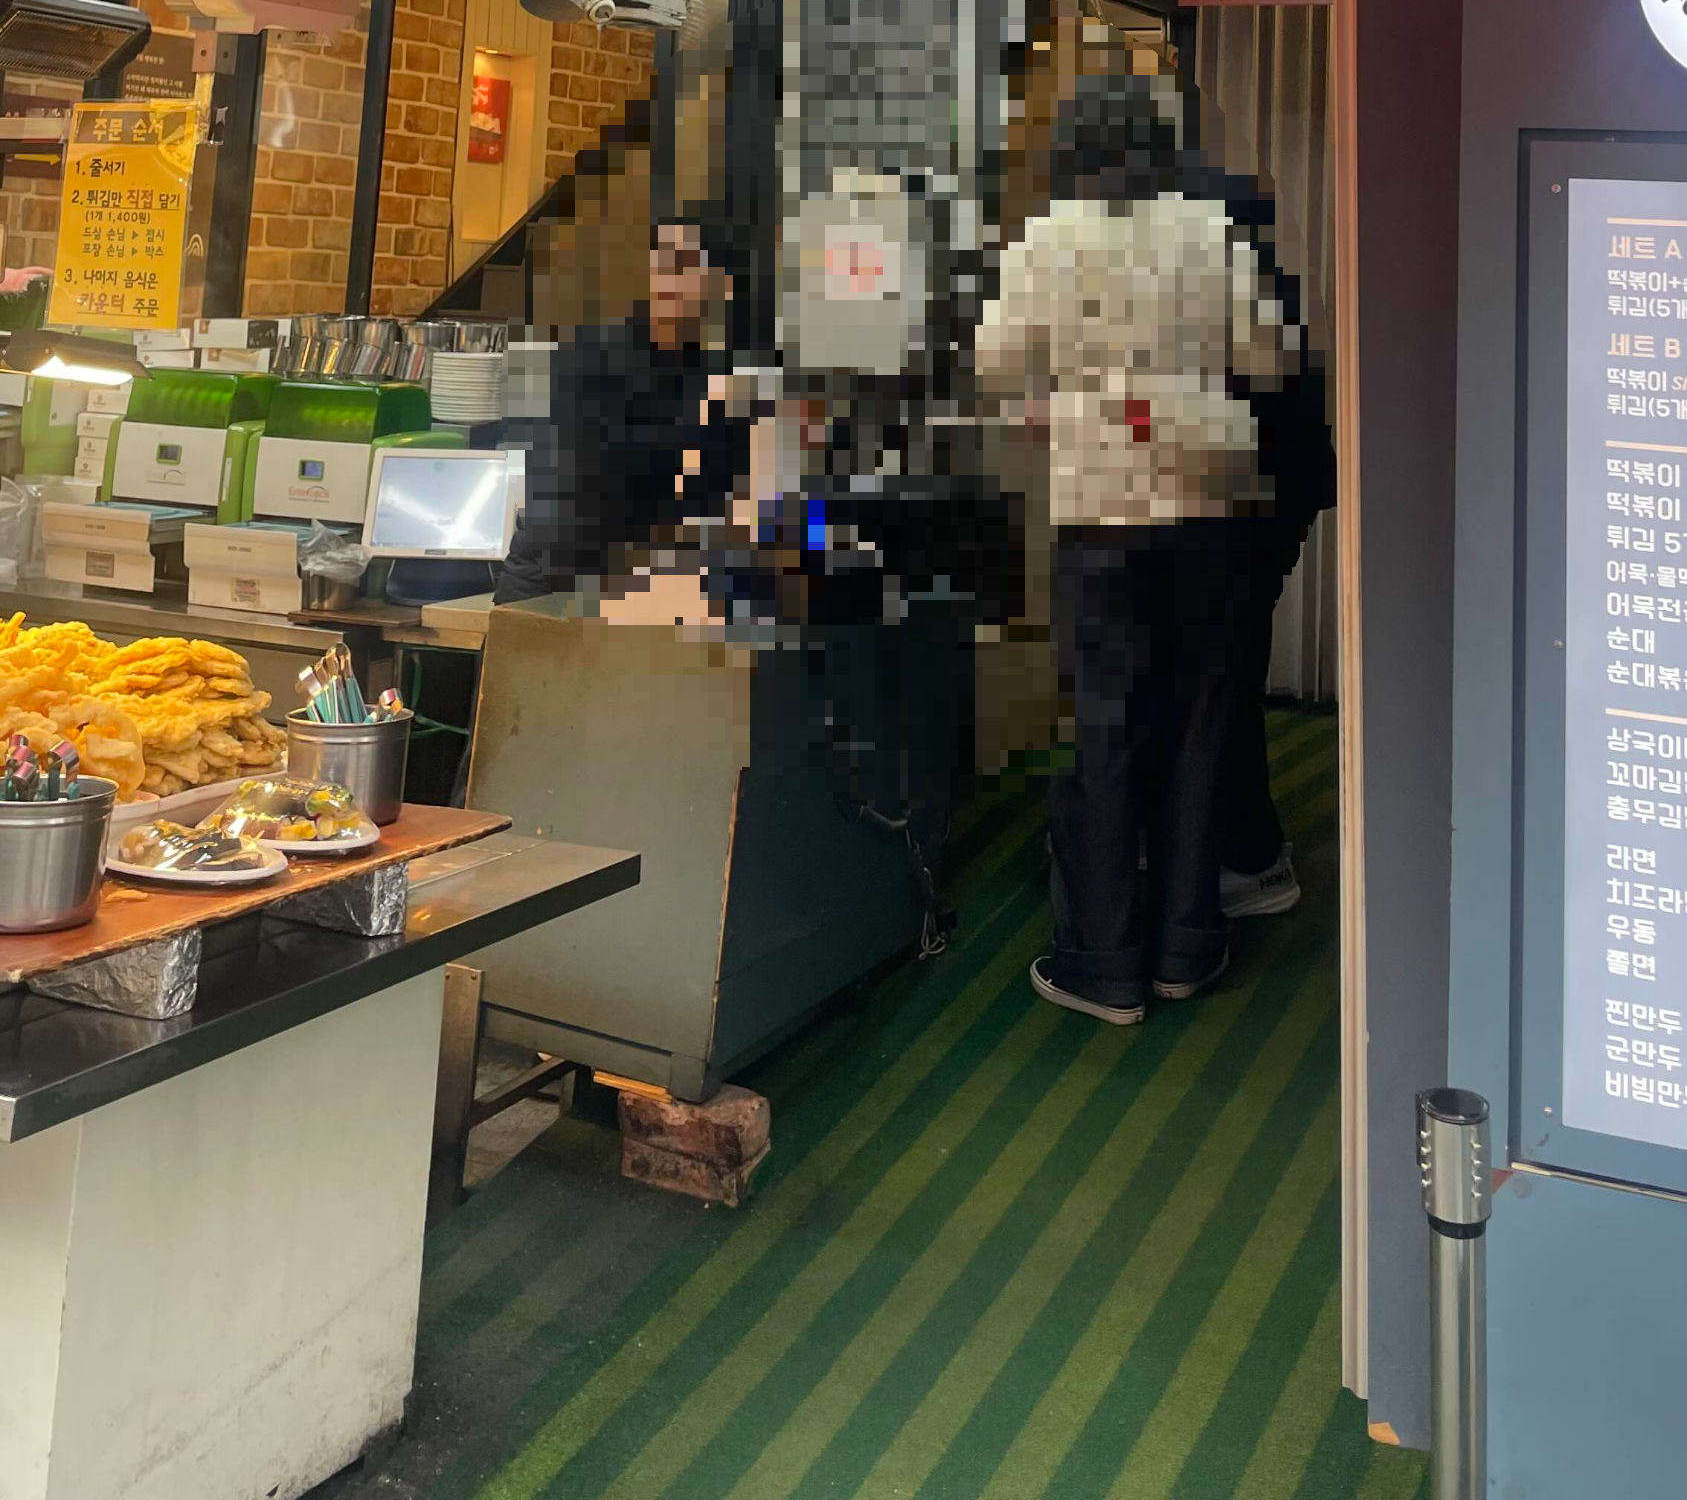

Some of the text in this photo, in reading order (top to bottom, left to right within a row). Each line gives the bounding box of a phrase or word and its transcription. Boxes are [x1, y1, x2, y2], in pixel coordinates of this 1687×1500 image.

[93, 118, 164, 142] 주문 순서
[89, 158, 125, 177] 줄서기
[86, 189, 122, 207] 튀김만
[127, 189, 154, 208] 직접
[159, 194, 180, 209] 담기
[107, 227, 125, 241] 손님
[146, 229, 165, 243] 접시
[1608, 236, 1682, 259] 세트 A
[106, 244, 125, 258] 손님
[145, 246, 164, 259] 박스
[84, 269, 118, 286] 나머지
[79, 293, 159, 317] 카운터 주문
[1607, 333, 1681, 358] 세트 B
[1607, 368, 1667, 392] 떡볶이
[1607, 459, 1680, 488] 떡볶이
[1607, 492, 1680, 521] 떡볶이
[1607, 525, 1687, 554] 튀김 5
[1607, 592, 1687, 623] 어묵전
[1607, 626, 1655, 654] 순대
[1607, 660, 1687, 691] 순대볶
[1607, 727, 1687, 760] 상국이
[1607, 761, 1687, 794] 꼬마김
[1607, 795, 1687, 829] 충무김
[1607, 844, 1656, 875] 라면
[1607, 878, 1687, 914] 치즈라
[1607, 914, 1656, 945] 우동
[1607, 949, 1656, 981] 쫄면
[1605, 999, 1682, 1035] 찐만두
[1606, 1035, 1682, 1071] 군만두
[1605, 1070, 1687, 1109] 비빔만
